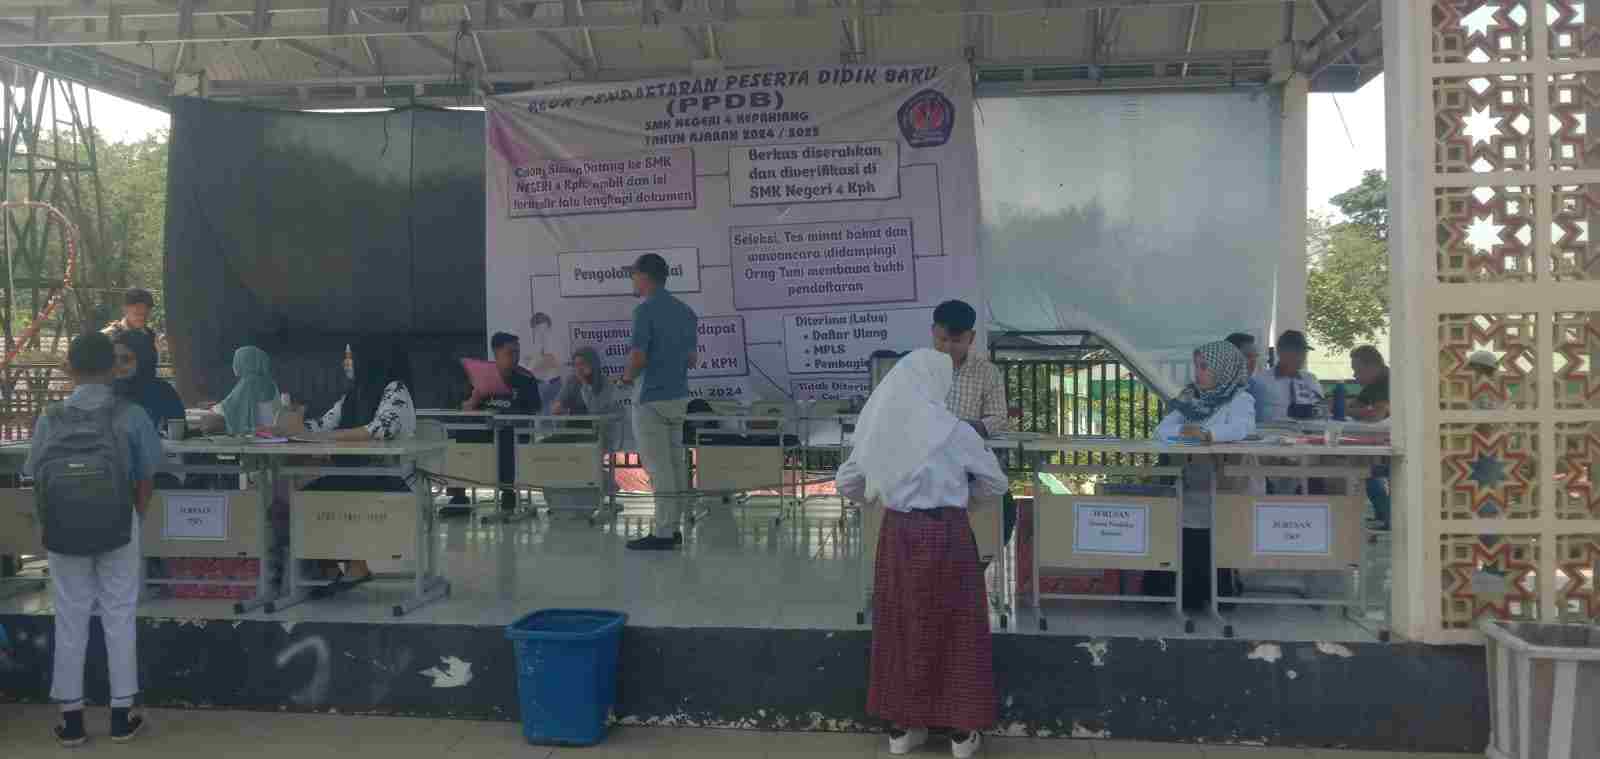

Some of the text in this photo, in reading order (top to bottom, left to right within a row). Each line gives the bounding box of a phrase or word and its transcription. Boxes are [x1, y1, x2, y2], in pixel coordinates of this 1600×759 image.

[726, 69, 809, 90] PESERTA
[817, 66, 878, 85] DIDIK
[885, 65, 938, 83] BARU
[666, 90, 784, 117] (PPDB)
[645, 120, 671, 131] SMK
[749, 144, 882, 161] Berkas diserahkan
[645, 156, 672, 169] SMK
[749, 167, 777, 180] dan
[862, 161, 878, 175] di
[626, 175, 650, 187] dan
[749, 183, 782, 200] SMK
[785, 182, 833, 199] Negeri
[847, 180, 877, 198] Kph
[884, 226, 908, 238] dan
[787, 281, 864, 297] pendaftaran
[573, 321, 737, 344] Pengumu dapat
[853, 328, 888, 341] Ulang
[708, 386, 744, 398] 2024
